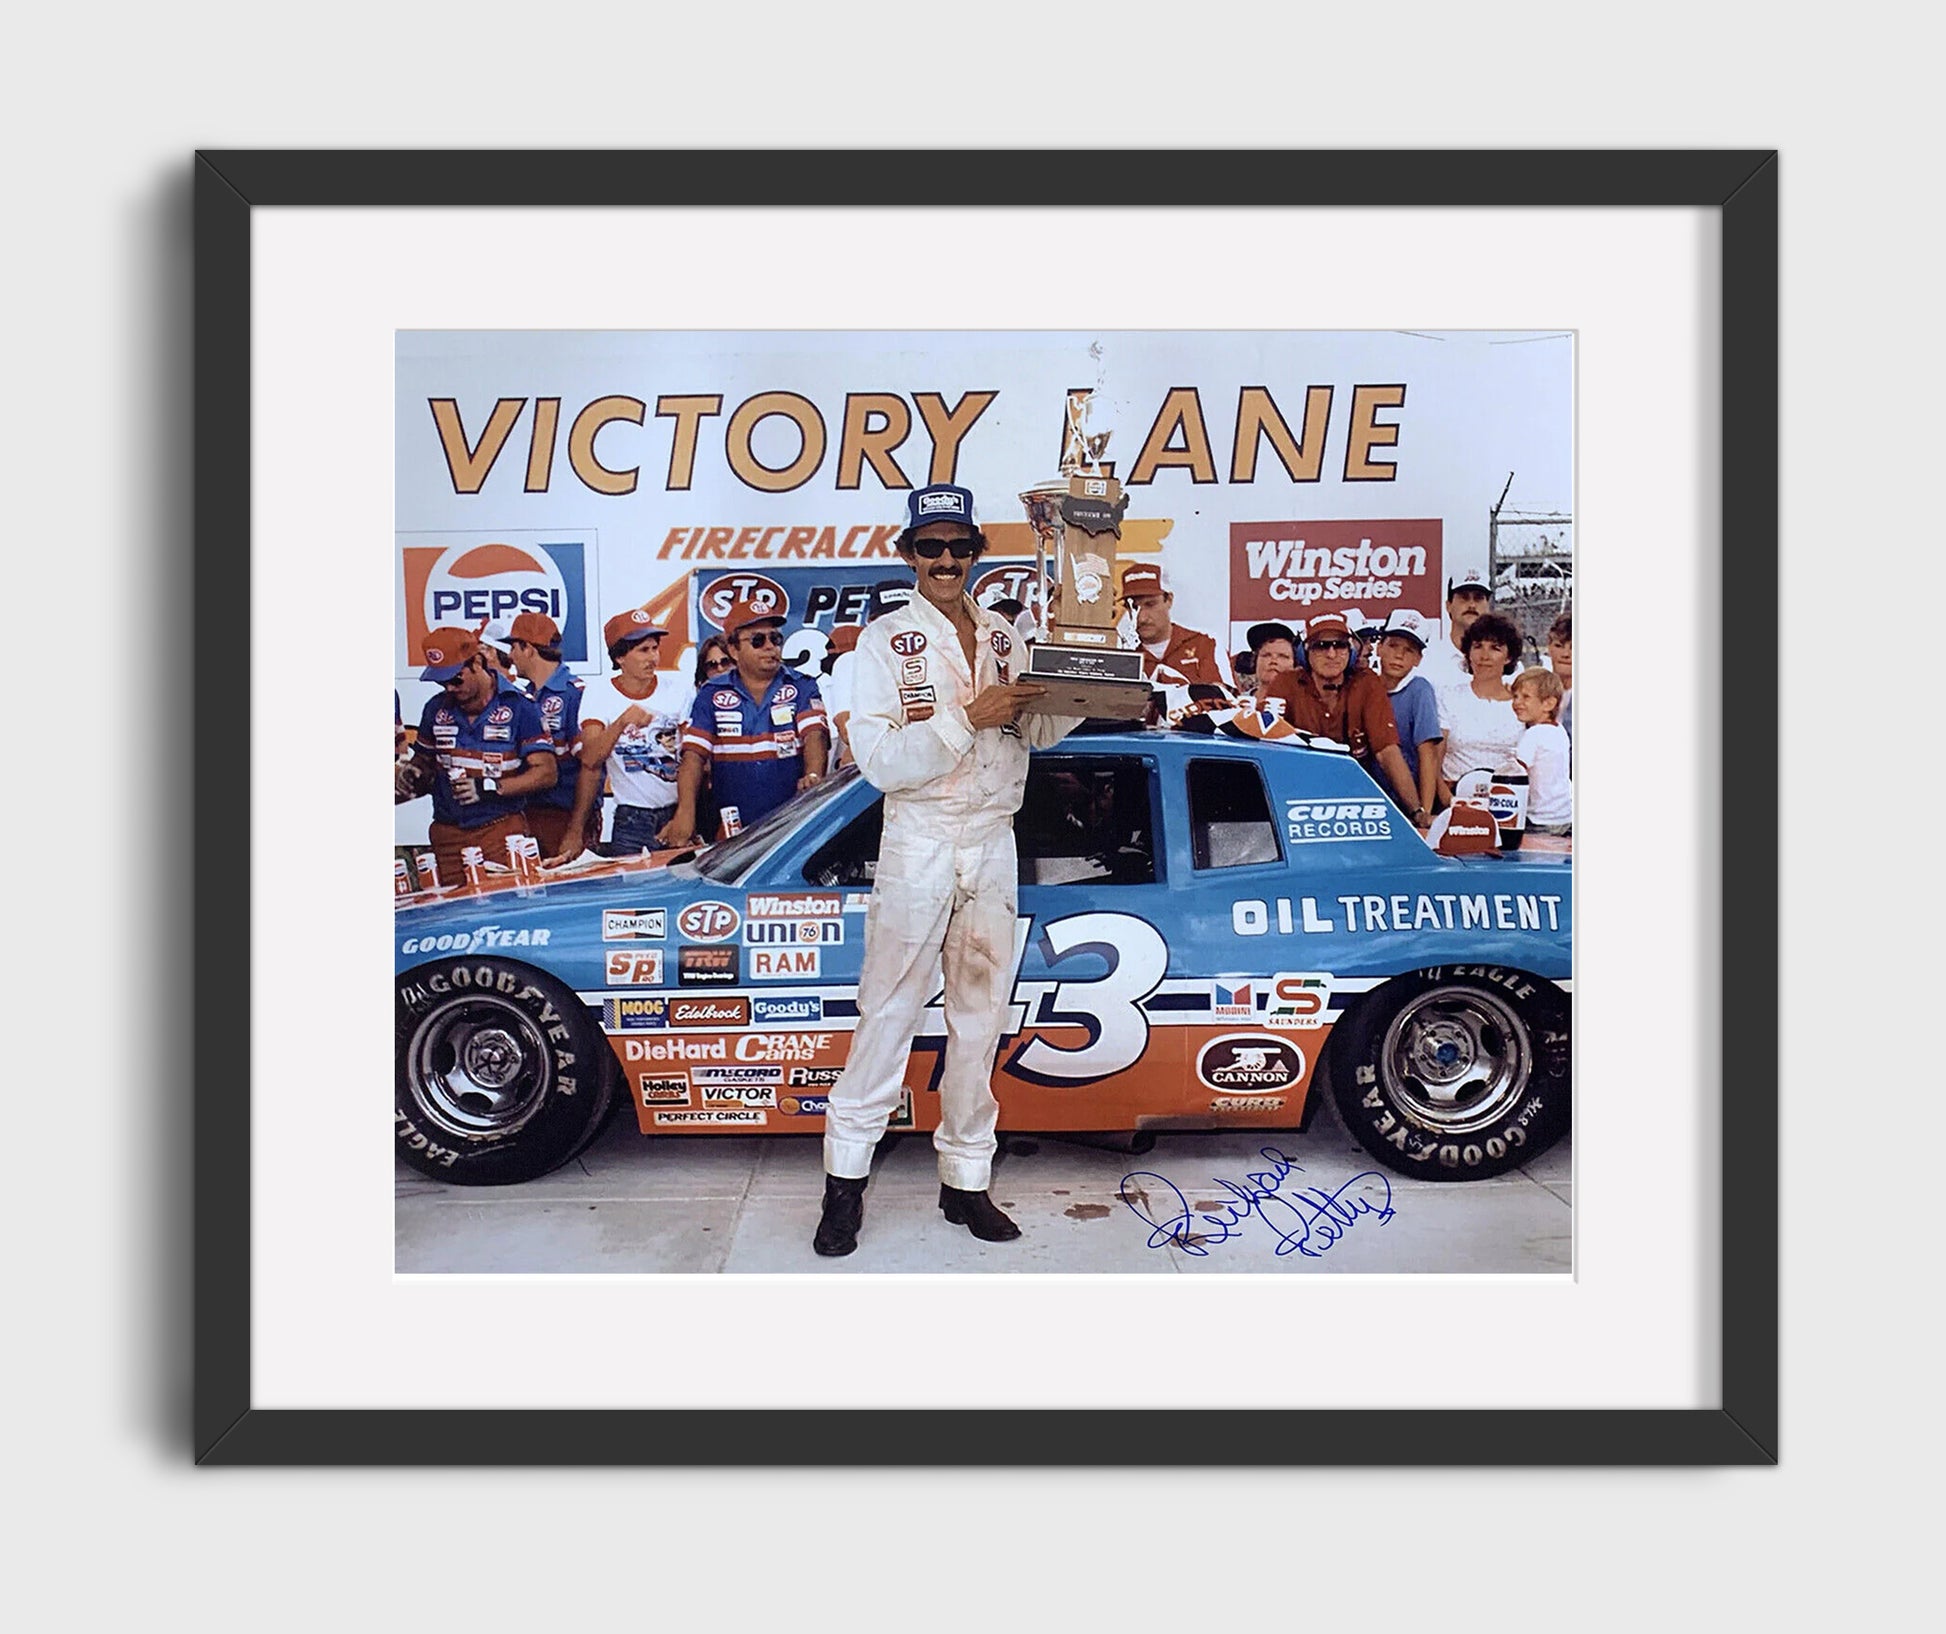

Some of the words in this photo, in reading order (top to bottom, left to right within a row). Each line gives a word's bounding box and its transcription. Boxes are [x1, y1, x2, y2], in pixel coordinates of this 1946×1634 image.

[428, 391, 999, 495] VICTORY
[1060, 384, 1407, 485] LANE
[1246, 538, 1426, 579] Winston
[711, 579, 777, 618] STP
[1269, 578, 1322, 605] Cup
[1325, 576, 1402, 601] Series
[433, 588, 560, 620] PEPSI
[895, 633, 925, 653] STP
[992, 633, 1010, 651] STP
[716, 693, 739, 704] STP
[773, 686, 796, 702] STP
[1287, 804, 1388, 822] CURB
[1289, 820, 1391, 838] RECORDS
[749, 896, 840, 916] Winston
[1232, 897, 1334, 936] OIL
[1338, 895, 1562, 933] TREATMENT
[608, 919, 662, 929] CHAMPION
[686, 905, 731, 934] STP
[402, 926, 551, 954] GOODYEAR
[684, 951, 733, 968] TRW
[756, 952, 815, 973] RAM
[1453, 966, 1536, 999] EAGLE
[622, 1000, 664, 1015] MOOG
[675, 1004, 741, 1020] Edelbrock
[756, 1001, 820, 1018] Goody's
[429, 966, 577, 1096] GOODYEAR
[625, 1038, 726, 1061] DieHard
[643, 1081, 686, 1093] Holley
[1212, 1072, 1288, 1082] CANNON
[705, 1088, 771, 1099] VICTOR
[658, 1113, 713, 1121] PERFECT
[716, 1112, 761, 1120] CIRCLE
[1356, 1063, 1526, 1168] GOODYEAR
